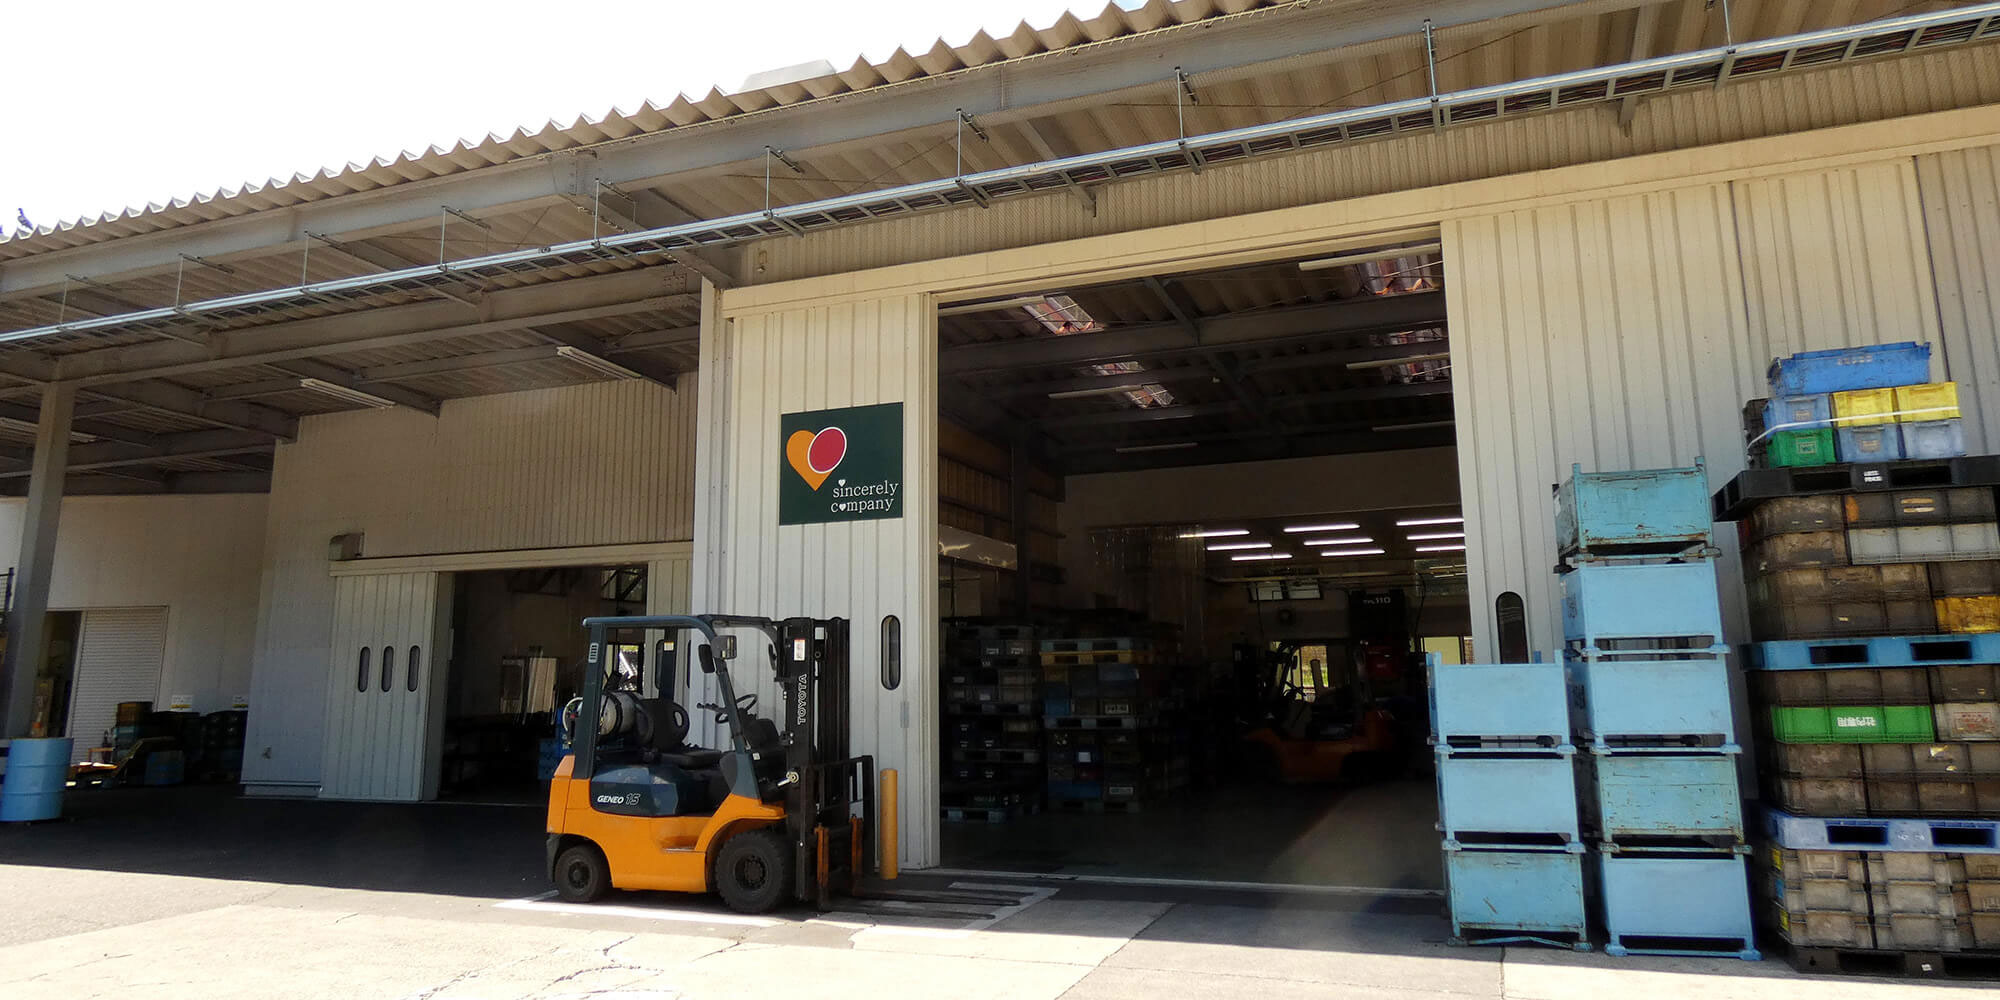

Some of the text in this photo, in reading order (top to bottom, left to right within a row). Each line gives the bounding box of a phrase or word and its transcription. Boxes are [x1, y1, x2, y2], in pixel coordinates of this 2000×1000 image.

[832, 479, 899, 498] sincerely
[797, 673, 807, 725] TOYOTA
[597, 793, 641, 805] GENEO 15
